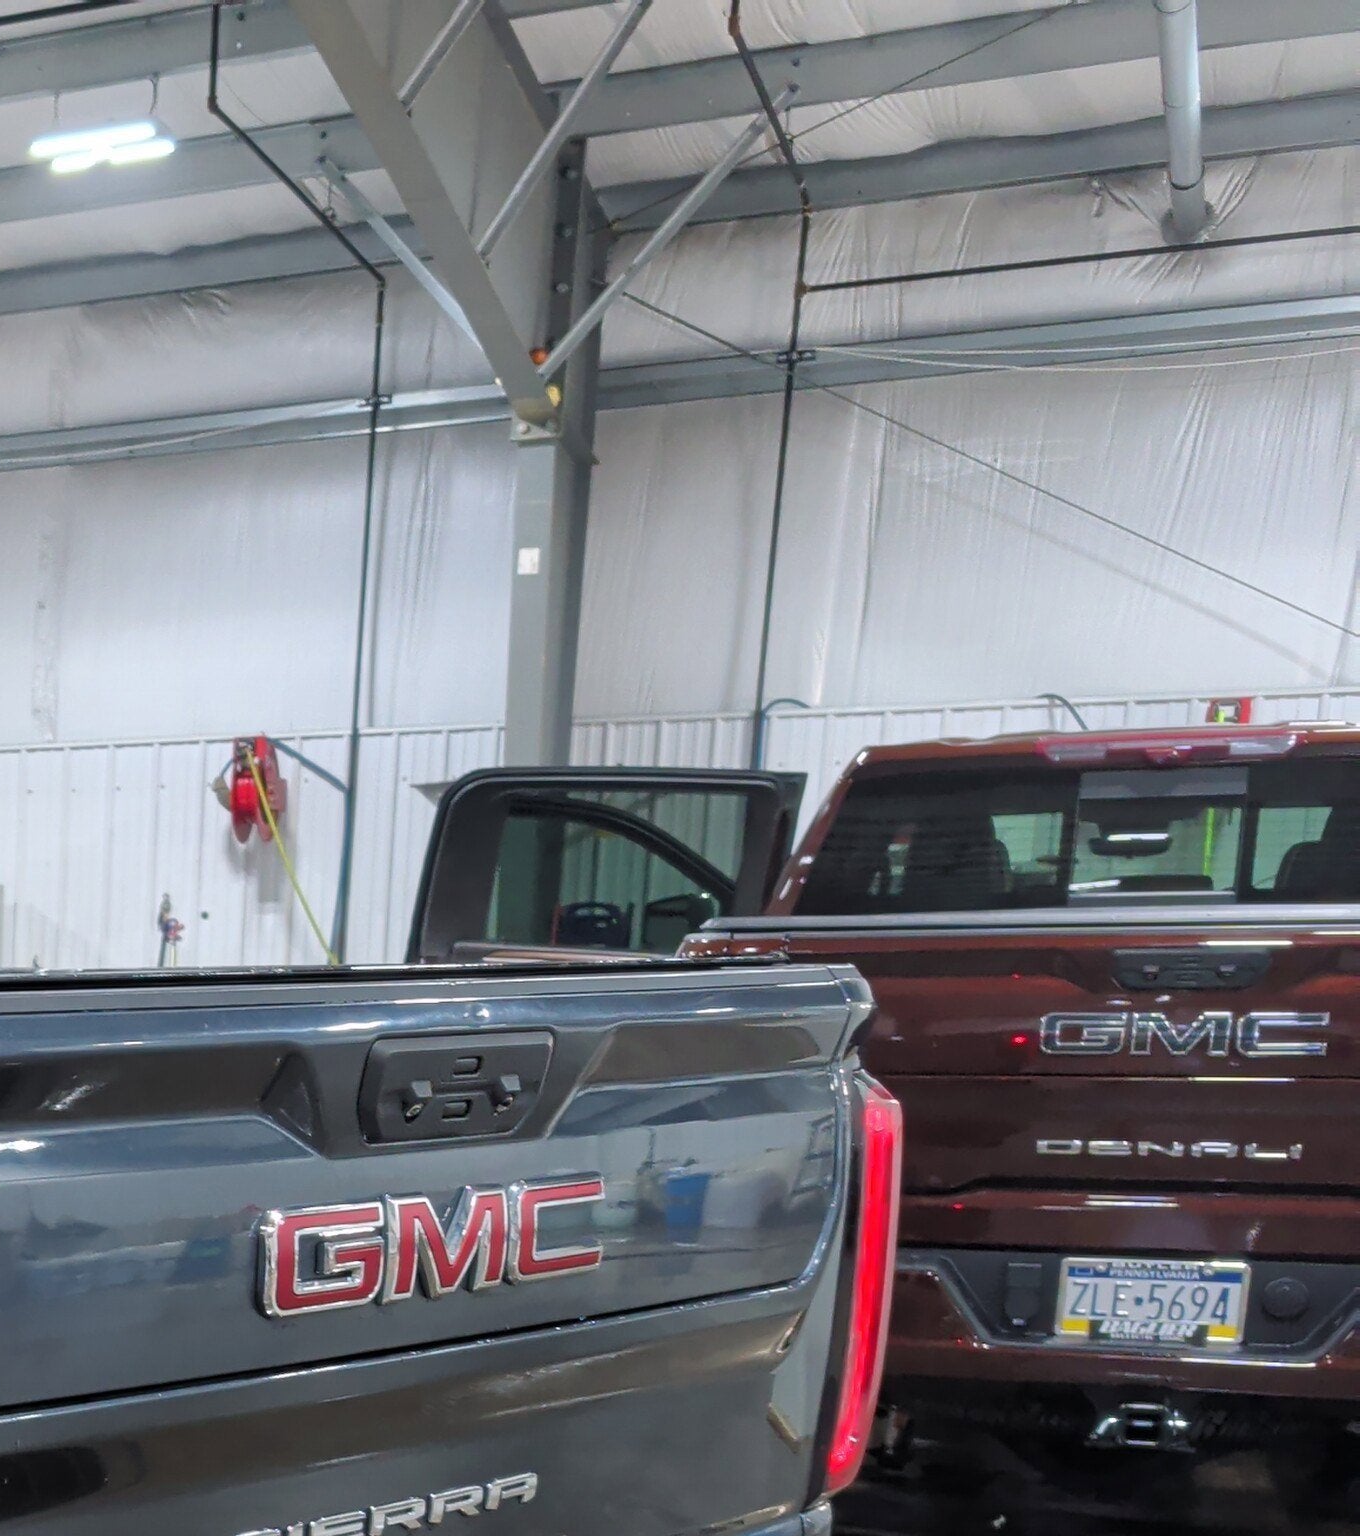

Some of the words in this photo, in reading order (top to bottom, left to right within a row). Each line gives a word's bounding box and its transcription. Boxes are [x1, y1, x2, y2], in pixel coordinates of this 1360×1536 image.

[1039, 1012, 1331, 1057] GMC
[1035, 1138, 1303, 1160] DENALI
[258, 1171, 605, 1319] GMC
[1109, 1268, 1201, 1280] PENNSYLVANIA
